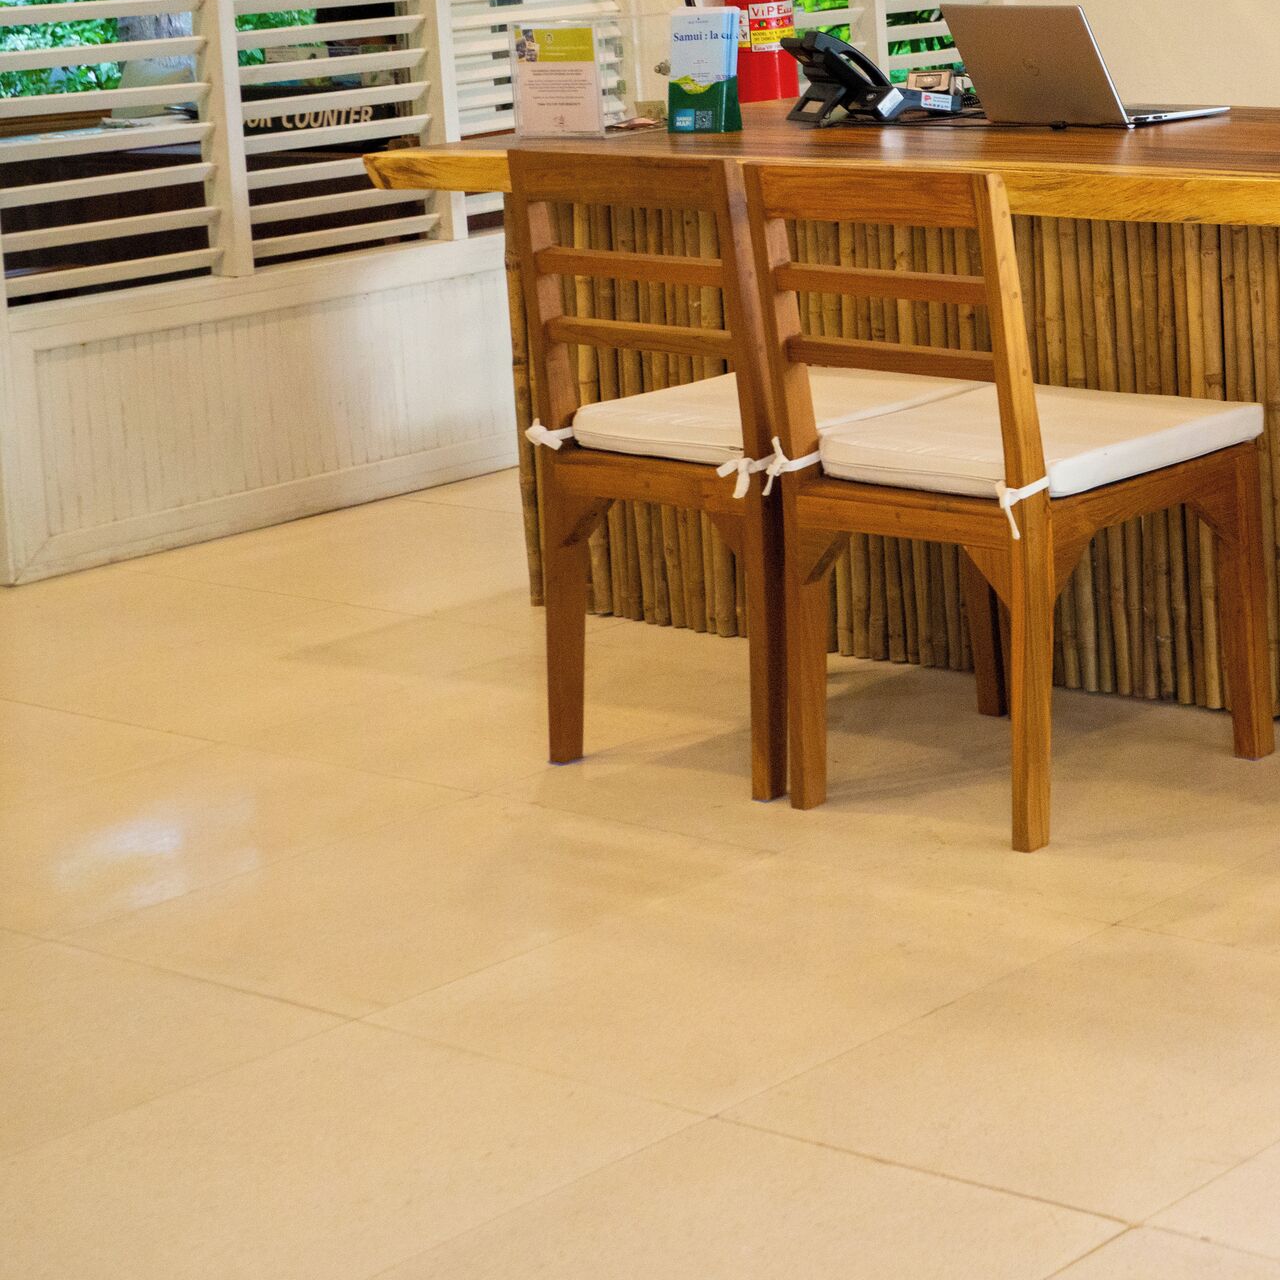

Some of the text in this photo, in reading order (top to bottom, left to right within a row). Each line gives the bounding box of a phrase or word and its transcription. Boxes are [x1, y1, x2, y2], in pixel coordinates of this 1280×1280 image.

[673, 31, 702, 42] Samui
[710, 30, 719, 40] la
[281, 106, 373, 128] COUNTER
